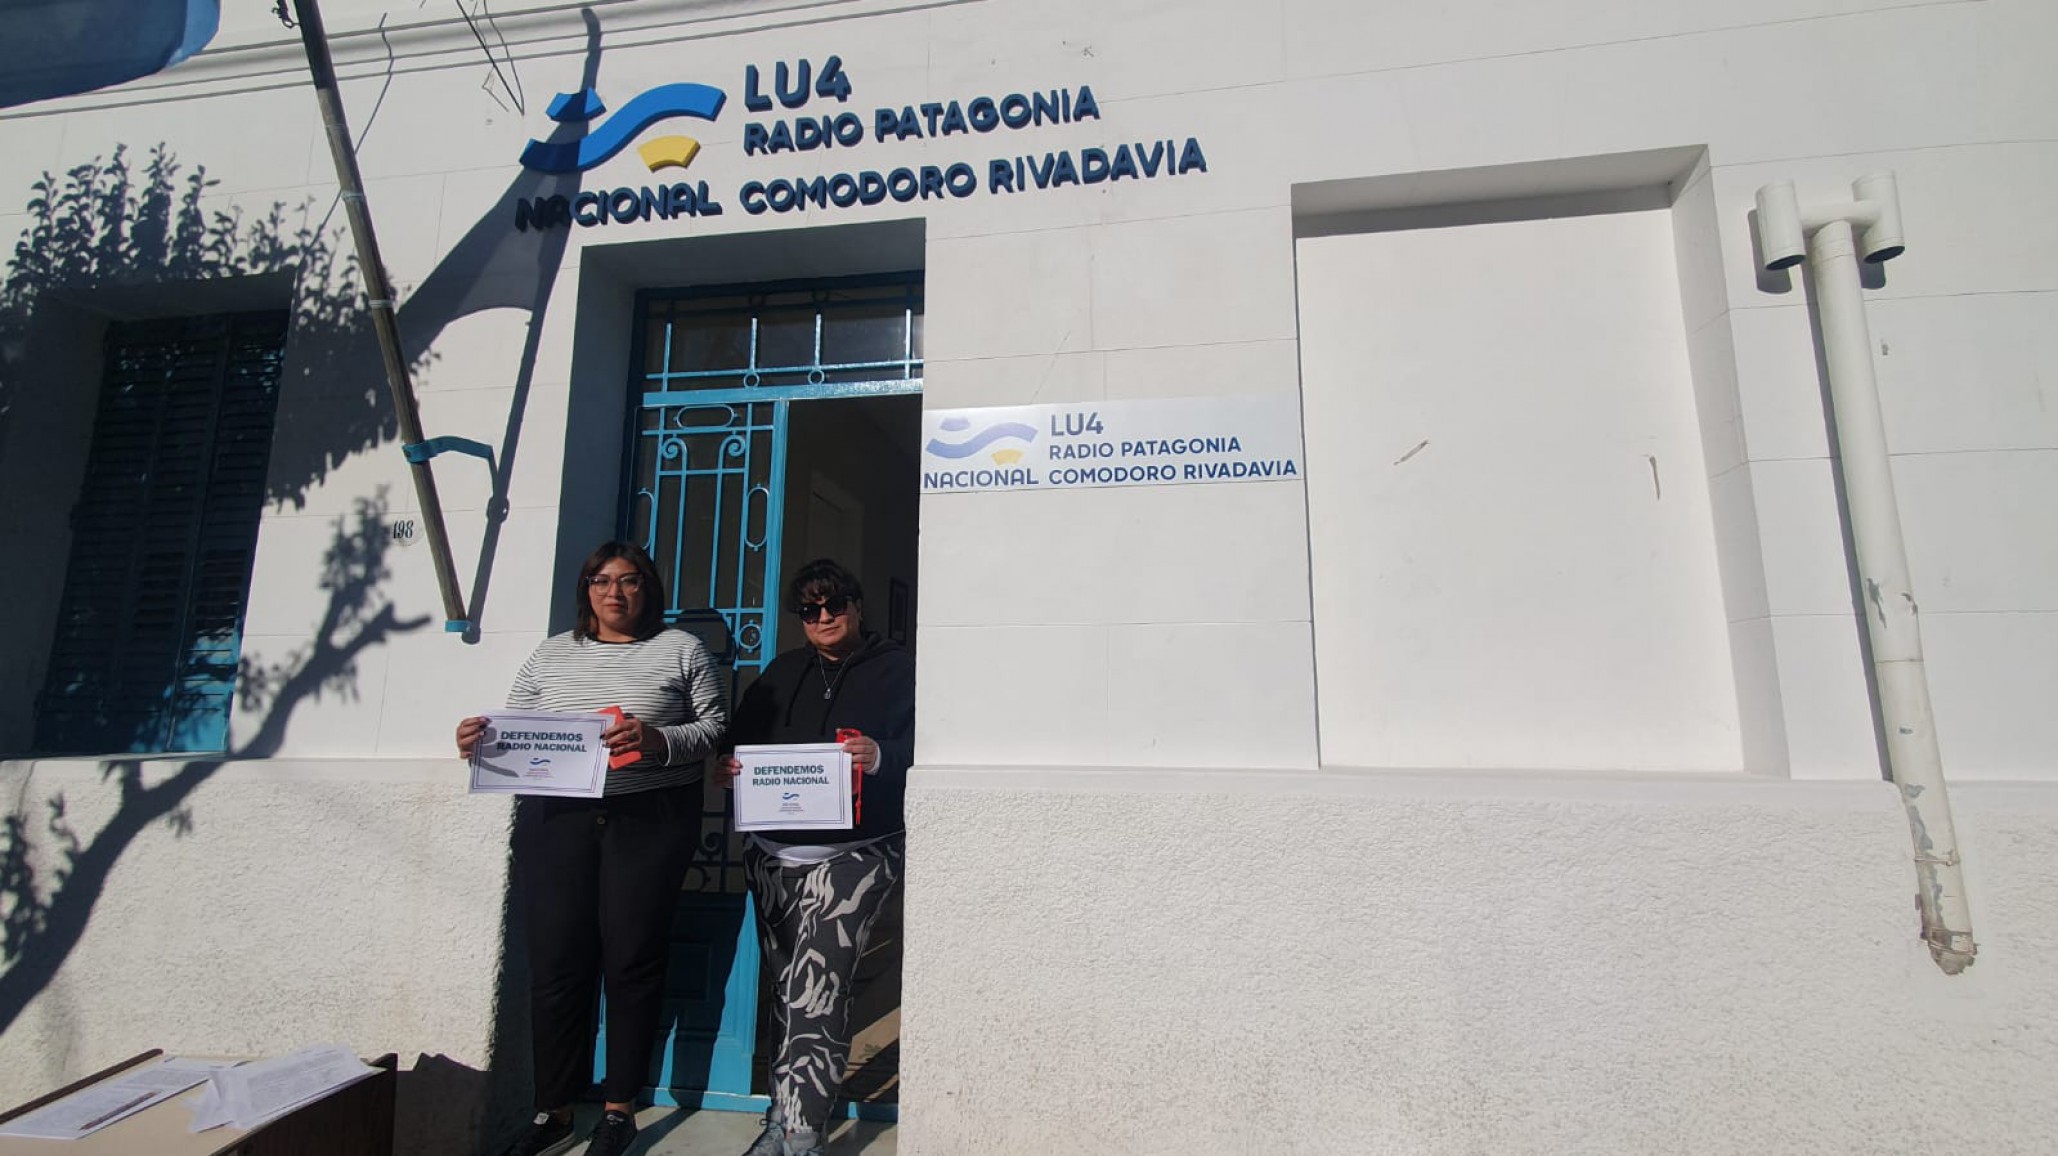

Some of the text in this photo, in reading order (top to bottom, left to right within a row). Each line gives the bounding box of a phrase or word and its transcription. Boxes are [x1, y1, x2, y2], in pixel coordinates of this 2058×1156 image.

[745, 55, 852, 112] LU4
[744, 85, 1100, 156] RADIO PATAGONIA
[740, 137, 1207, 215] COMODORO RIVADAVIA
[515, 180, 722, 232] NACIONAL
[1051, 412, 1104, 436] LU4
[1049, 437, 1242, 460] RADIO PATAGONIA
[924, 467, 1039, 489] NACIONAL
[1049, 460, 1297, 485] COMODORO RIVADAVIA
[393, 520, 414, 539] 198
[497, 742, 587, 752] RADIO NACIONAL
[501, 731, 583, 742] DEFENDEMOS
[753, 776, 829, 786] RADIO NACIONAL
[754, 765, 824, 775] DEFENDEMOS
